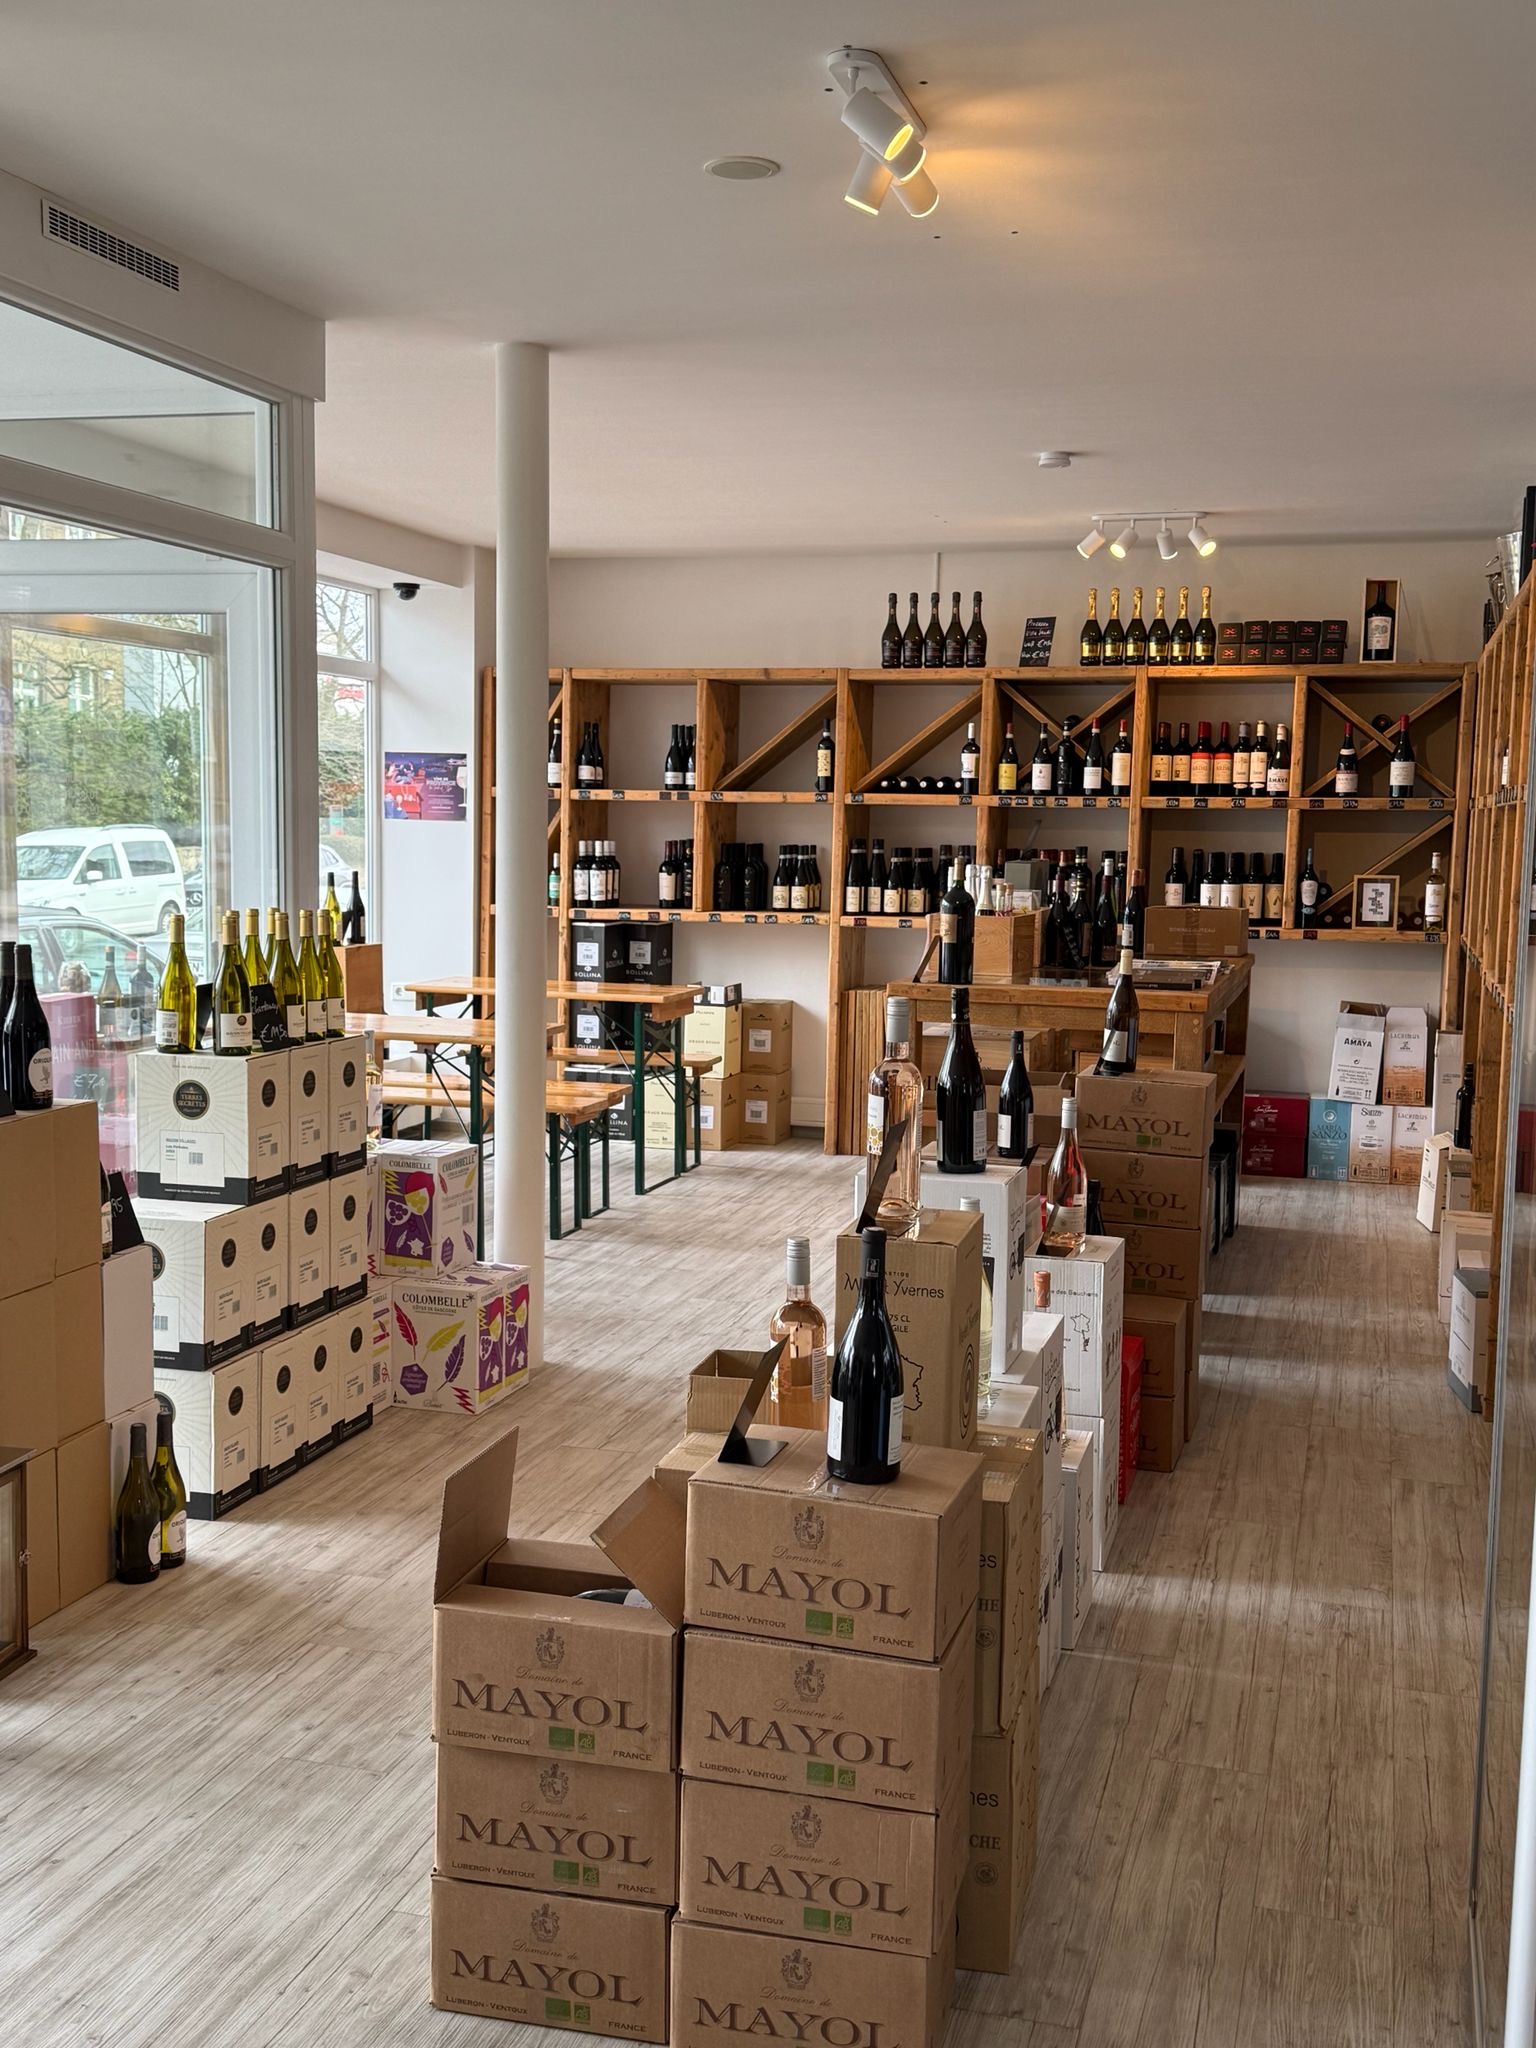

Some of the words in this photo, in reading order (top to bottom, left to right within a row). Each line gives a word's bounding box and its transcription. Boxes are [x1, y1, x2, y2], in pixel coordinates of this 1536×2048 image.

[1344, 1038, 1372, 1048] AMAYA
[1085, 1112, 1191, 1138] MAYOL
[1311, 1130, 1347, 1140] SANZO
[389, 1160, 431, 1170] COLOMBELLE
[442, 1154, 476, 1173] COLOMBELLE
[1127, 1260, 1184, 1281] YOL
[893, 1279, 944, 1299] Yvernes
[402, 1292, 468, 1309] COLOMBELLE
[900, 1314, 911, 1322] CL
[891, 1325, 909, 1333] GILE
[772, 1545, 827, 1565] Domaine
[705, 1557, 913, 1620] MAYOL
[700, 1608, 741, 1622] LUBERON
[747, 1616, 787, 1629] VENTOUX
[873, 1635, 915, 1648] FRANCE
[516, 1666, 568, 1685] Domaine
[452, 1678, 649, 1735] MAYOL
[773, 1698, 827, 1718] Domaine
[447, 1729, 486, 1740] LUBERON
[491, 1734, 531, 1746] VENTOUX
[704, 1710, 915, 1773] MAYOL
[613, 1750, 652, 1761] FRANCE
[700, 1762, 742, 1775] LUBERON
[747, 1769, 788, 1782] VENTOUX
[875, 1788, 917, 1800] FRANCE
[520, 1800, 571, 1819] Domaine
[456, 1812, 654, 1868] MAYOL
[769, 1843, 825, 1864] Domaine
[452, 1861, 491, 1873] LUBERON
[495, 1867, 536, 1879] VENTOUX
[617, 1883, 657, 1894] FRANCE
[702, 1855, 910, 1918] MAYOL
[697, 1905, 738, 1919] LUBERON
[744, 1912, 785, 1926] VENTOUX
[512, 1938, 562, 1958] Domaine
[870, 1933, 913, 1945] FRANCE
[450, 1949, 645, 2008] MAYOL
[445, 1995, 485, 2007] LUBERON
[490, 2002, 528, 2014] VENTOUX
[760, 1986, 815, 2004] Domaine
[608, 2021, 647, 2032] FRANCE
[693, 1996, 902, 2048] MAYOL
